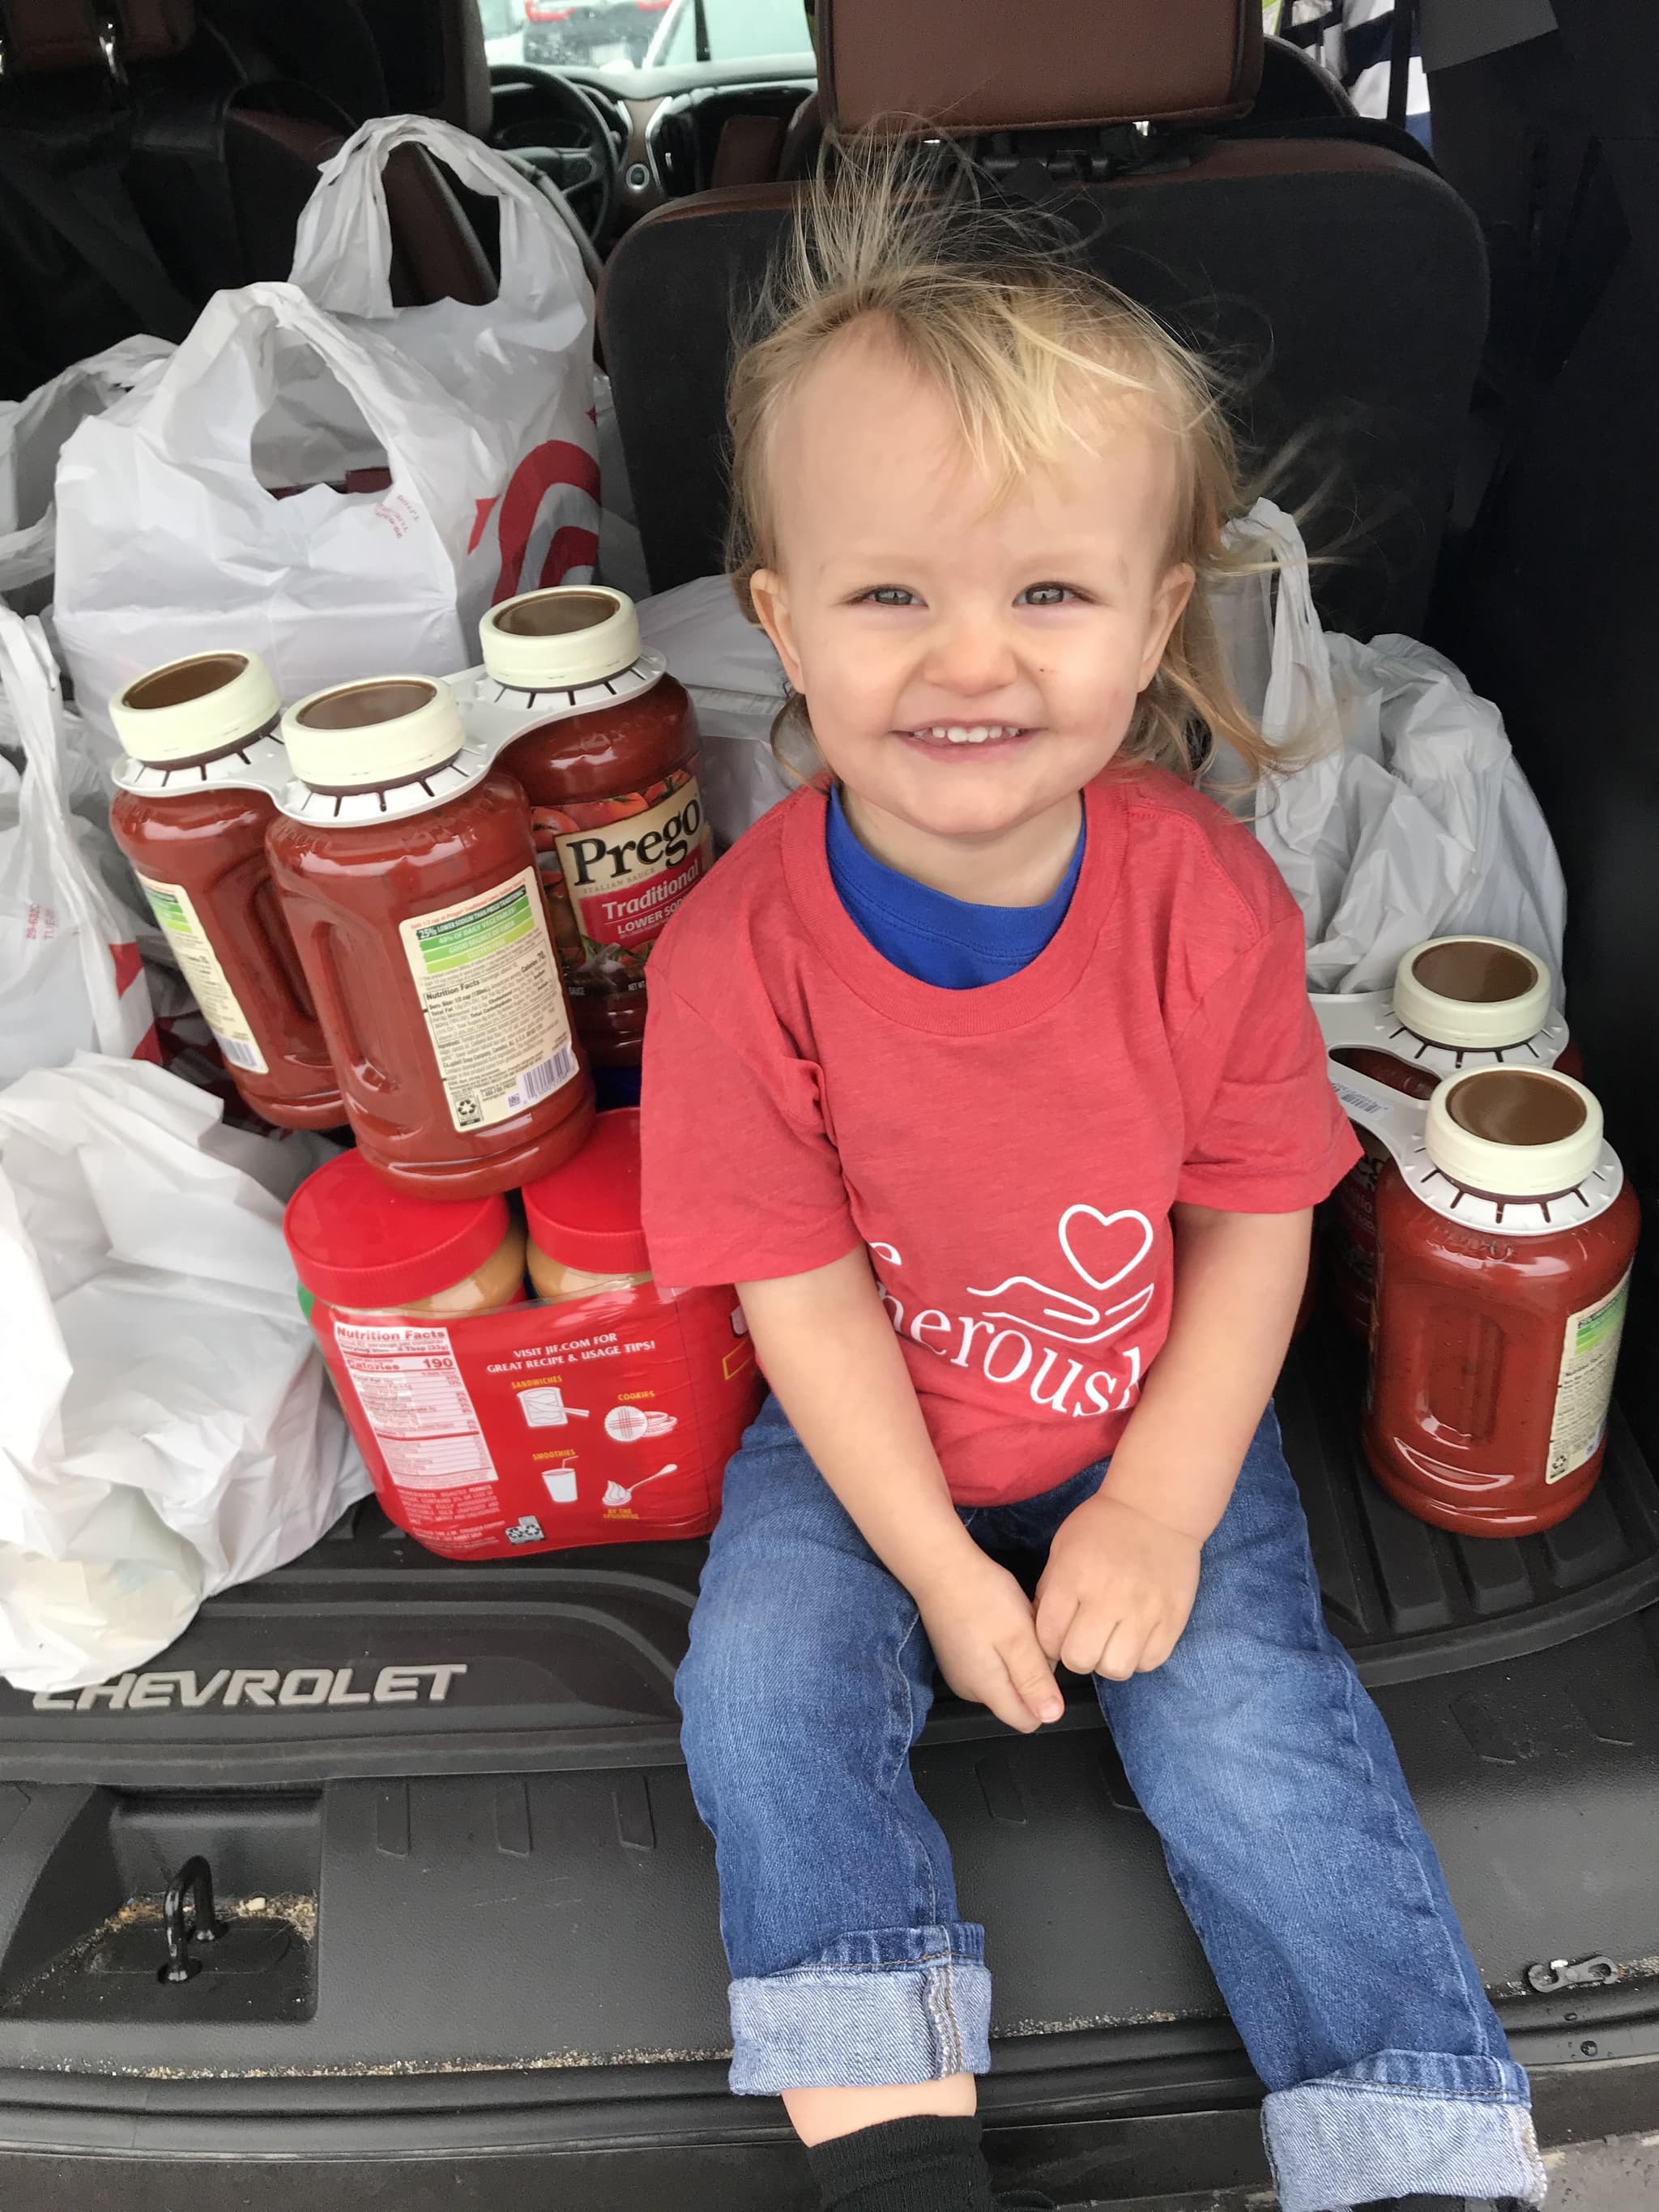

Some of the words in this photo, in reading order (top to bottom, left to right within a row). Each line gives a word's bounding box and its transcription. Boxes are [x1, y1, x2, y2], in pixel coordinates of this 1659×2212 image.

[566, 799, 700, 886] Prego
[583, 880, 624, 894] ITALIAN
[627, 867, 655, 882] SAUCE
[602, 859, 700, 920] Traditional
[617, 911, 663, 934] LOWER
[664, 897, 686, 916] SOD
[419, 926, 437, 939] 25%
[437, 920, 455, 932] LOWER
[449, 941, 467, 953] GOOD
[426, 986, 459, 1000] Nutrition
[460, 980, 480, 991] Facts
[337, 1326, 400, 1340] Nutrition
[405, 1330, 446, 1340] Facts
[487, 1362, 522, 1373] GREAT
[526, 1355, 565, 1368] RECIPE
[568, 1353, 578, 1362] &
[581, 1345, 621, 1360] USAGE
[625, 1340, 656, 1353] TIPS!
[513, 1347, 542, 1358] VISIT
[545, 1338, 591, 1355] JIF.COM
[594, 1332, 617, 1345] FOR
[877, 1281, 1141, 1417] nerousl
[348, 1359, 400, 1370] Calories
[423, 1357, 454, 1369] 190
[511, 1375, 563, 1389] SANDWICHES
[617, 1390, 655, 1401] COOKIES
[532, 1449, 576, 1460] SMOOTHIES
[32, 1663, 467, 1711] CHEVROLET
